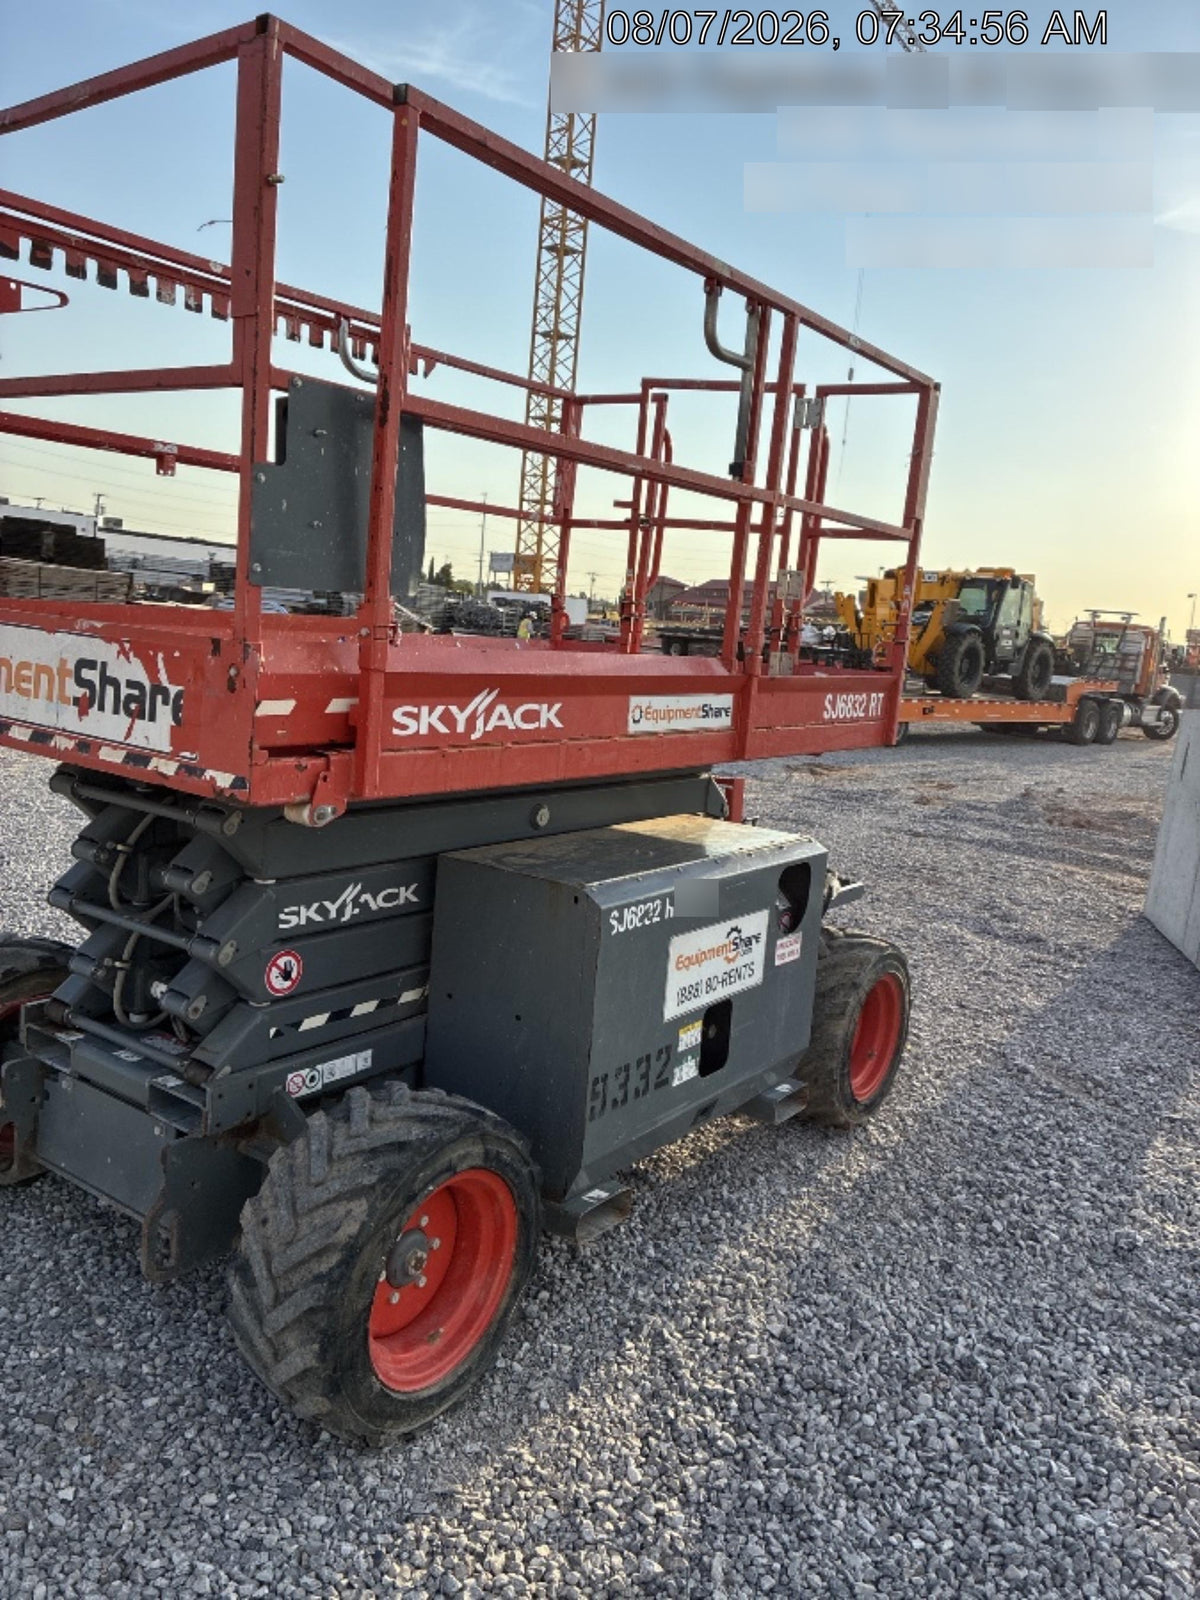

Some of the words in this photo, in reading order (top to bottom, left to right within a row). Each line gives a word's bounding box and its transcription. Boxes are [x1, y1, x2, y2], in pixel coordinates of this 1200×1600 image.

[392, 688, 564, 740] SKYJACK
[823, 693, 867, 719] SJ6832
[869, 693, 885, 717] RT
[278, 883, 419, 929] SKYJACK
